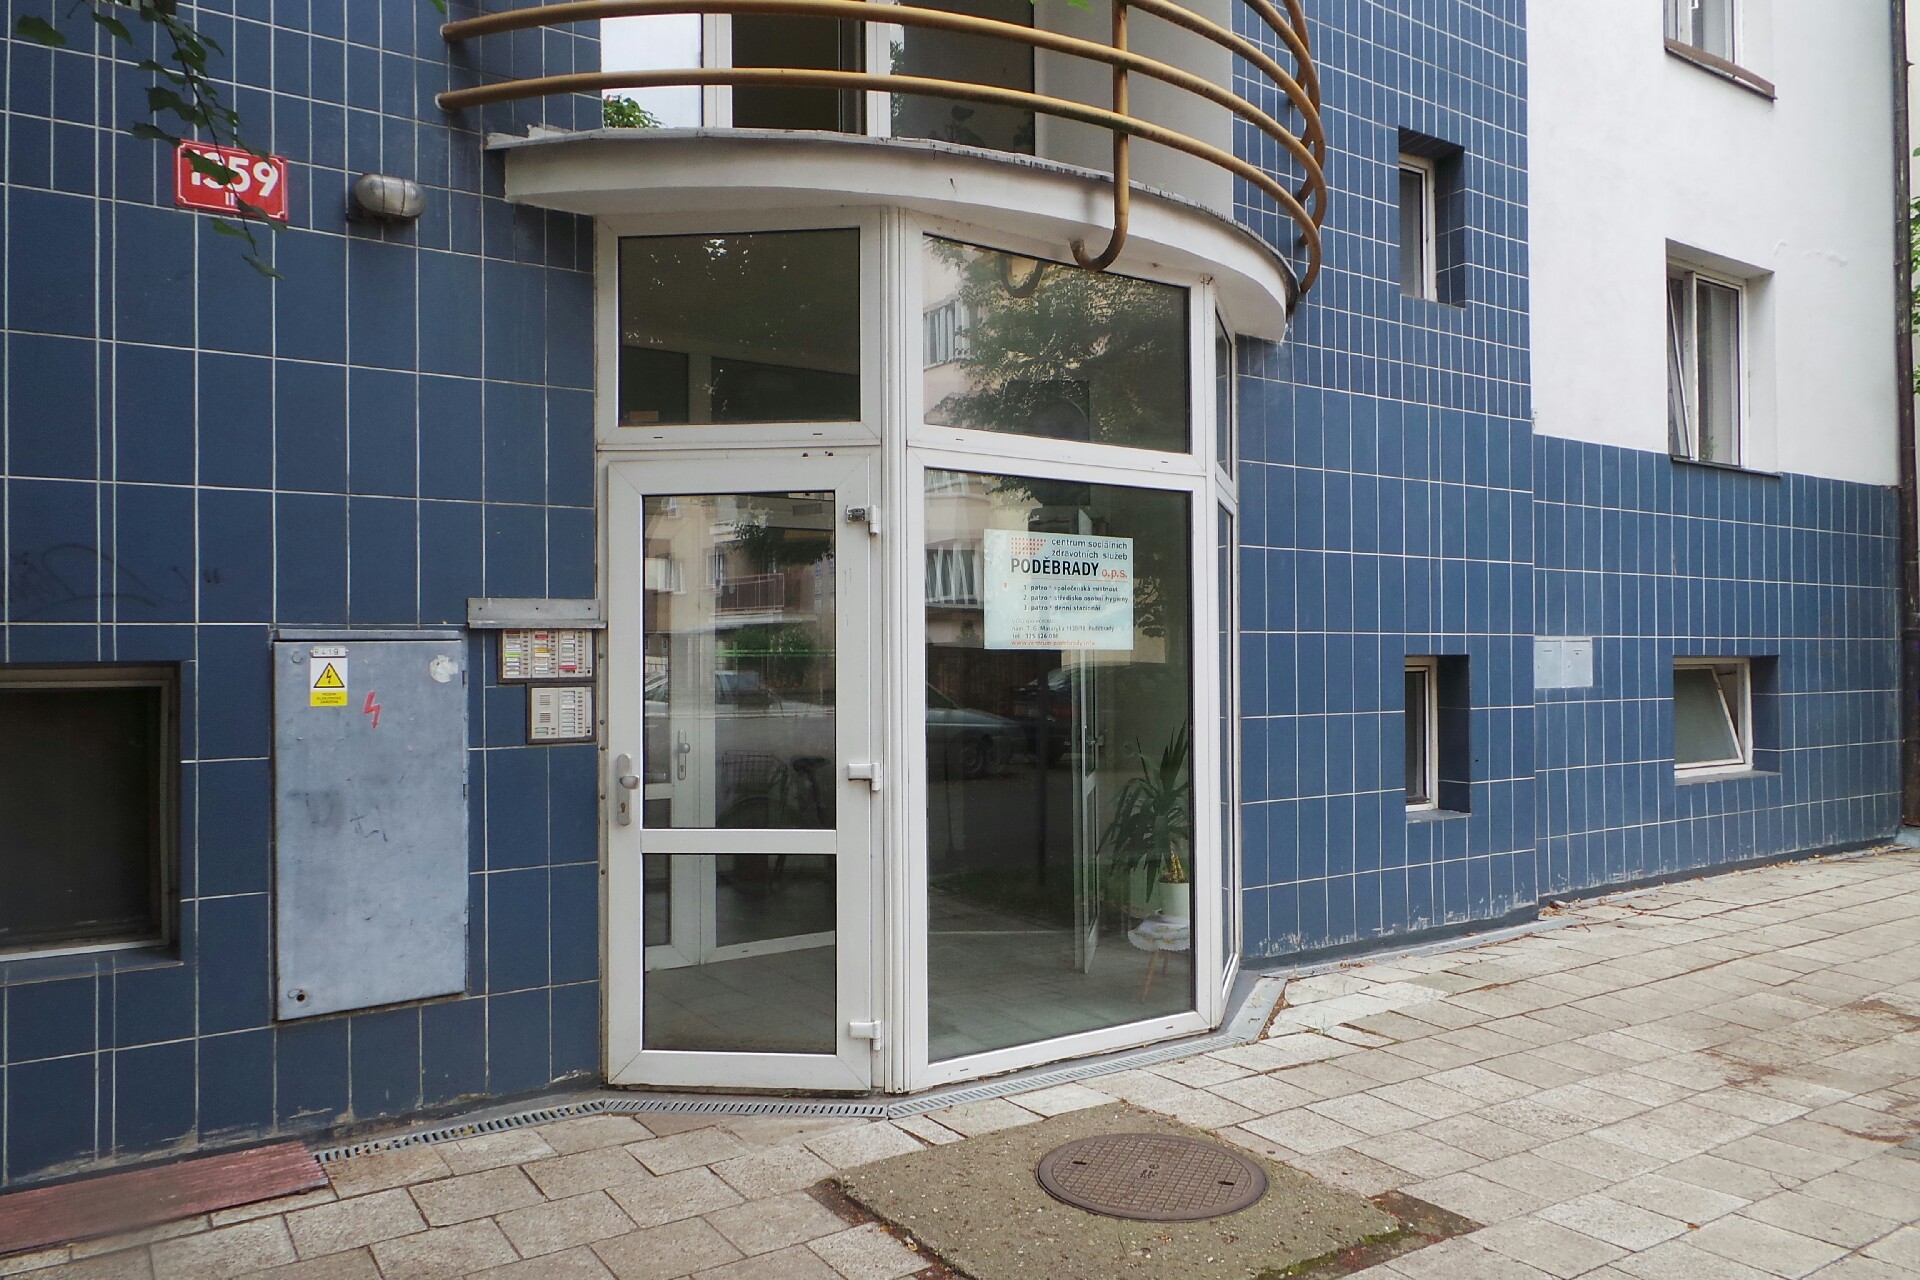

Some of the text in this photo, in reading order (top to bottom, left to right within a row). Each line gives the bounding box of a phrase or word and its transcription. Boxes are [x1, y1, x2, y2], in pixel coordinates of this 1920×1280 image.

[1051, 538, 1128, 549] centrum sociálních
[1051, 549, 1128, 560] zdravotních služeb
[1010, 556, 1128, 579] PODĚBRADY o.p.s.
